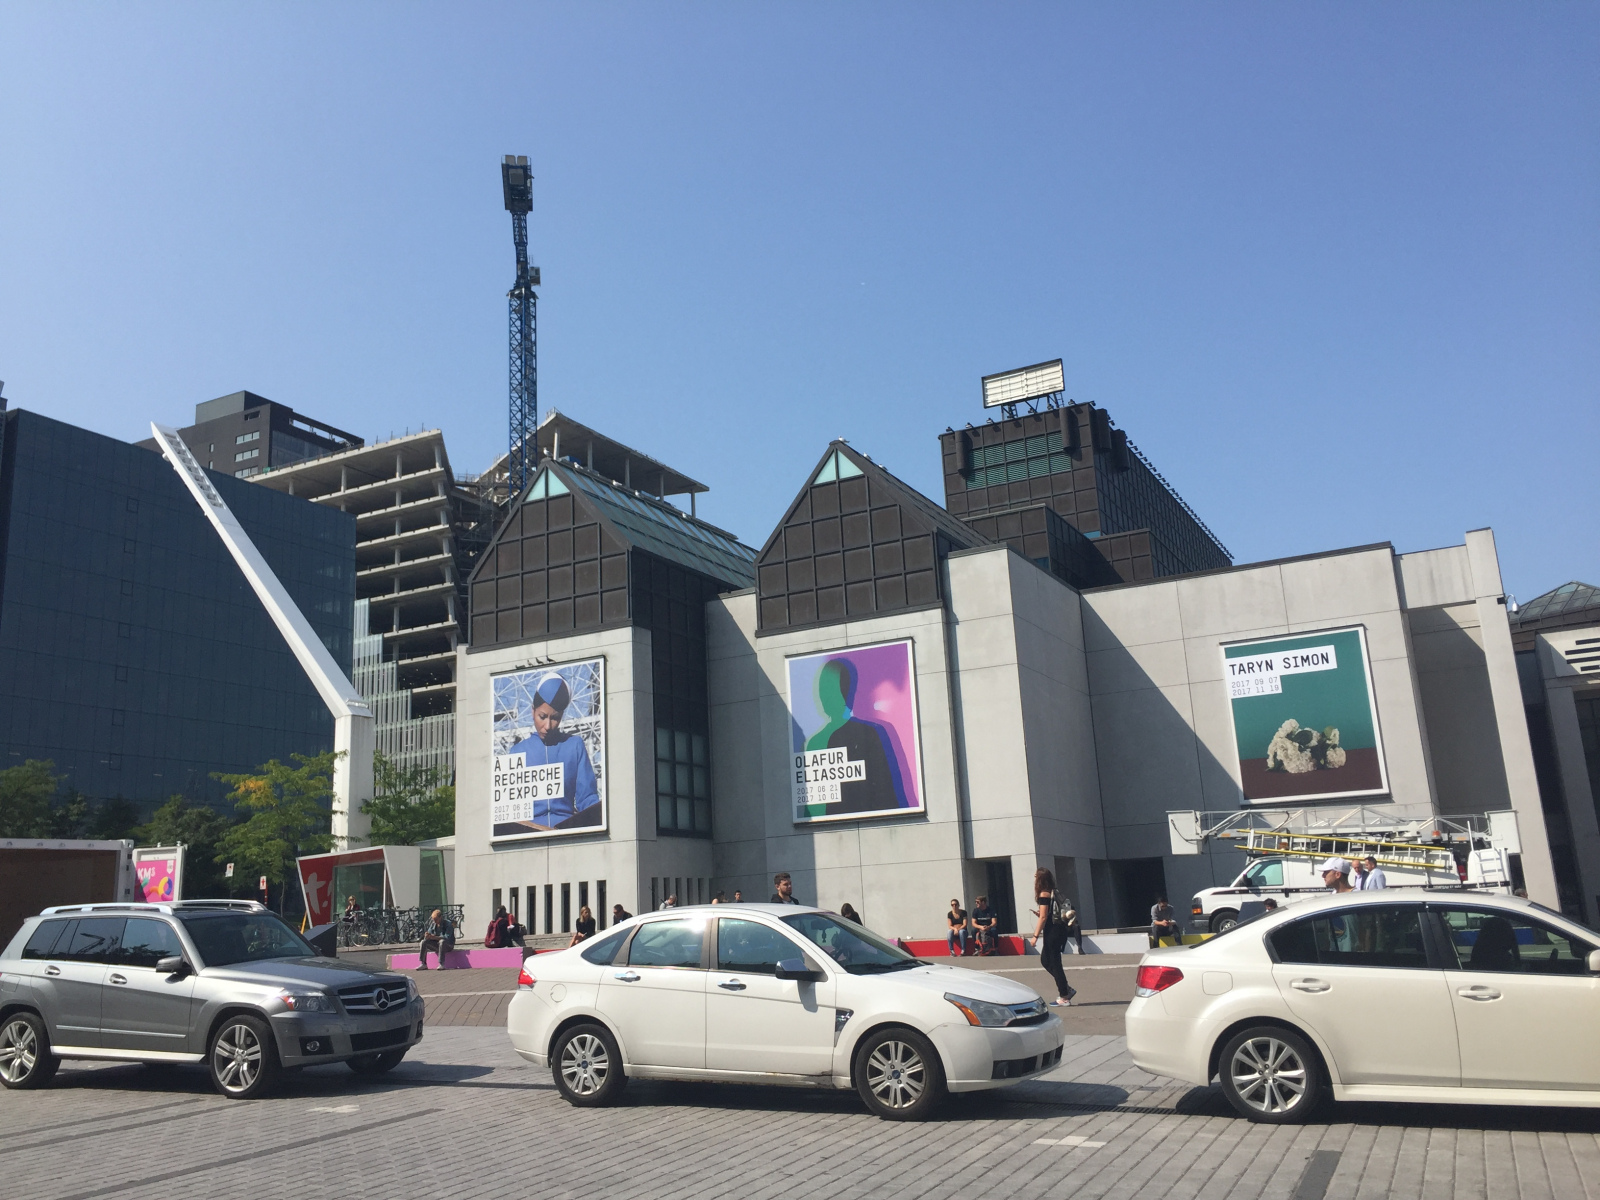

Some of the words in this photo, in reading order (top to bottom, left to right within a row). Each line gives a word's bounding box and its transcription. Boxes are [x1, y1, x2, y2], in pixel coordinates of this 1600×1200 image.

[1229, 660, 1274, 676] TARYN
[1283, 652, 1330, 670] SIMON
[1231, 680, 1250, 688] 2017
[1232, 688, 1250, 696] 2017
[494, 757, 501, 772] À
[509, 757, 524, 770] LA
[795, 752, 844, 768] OLAFUR
[494, 767, 560, 787] RECHERCHE
[796, 764, 862, 784] ELIASSON
[494, 785, 538, 802] D'EXPO
[546, 783, 561, 796] 67
[798, 795, 814, 804] 2017
[494, 805, 510, 814] 2017
[494, 813, 510, 822] 2017
